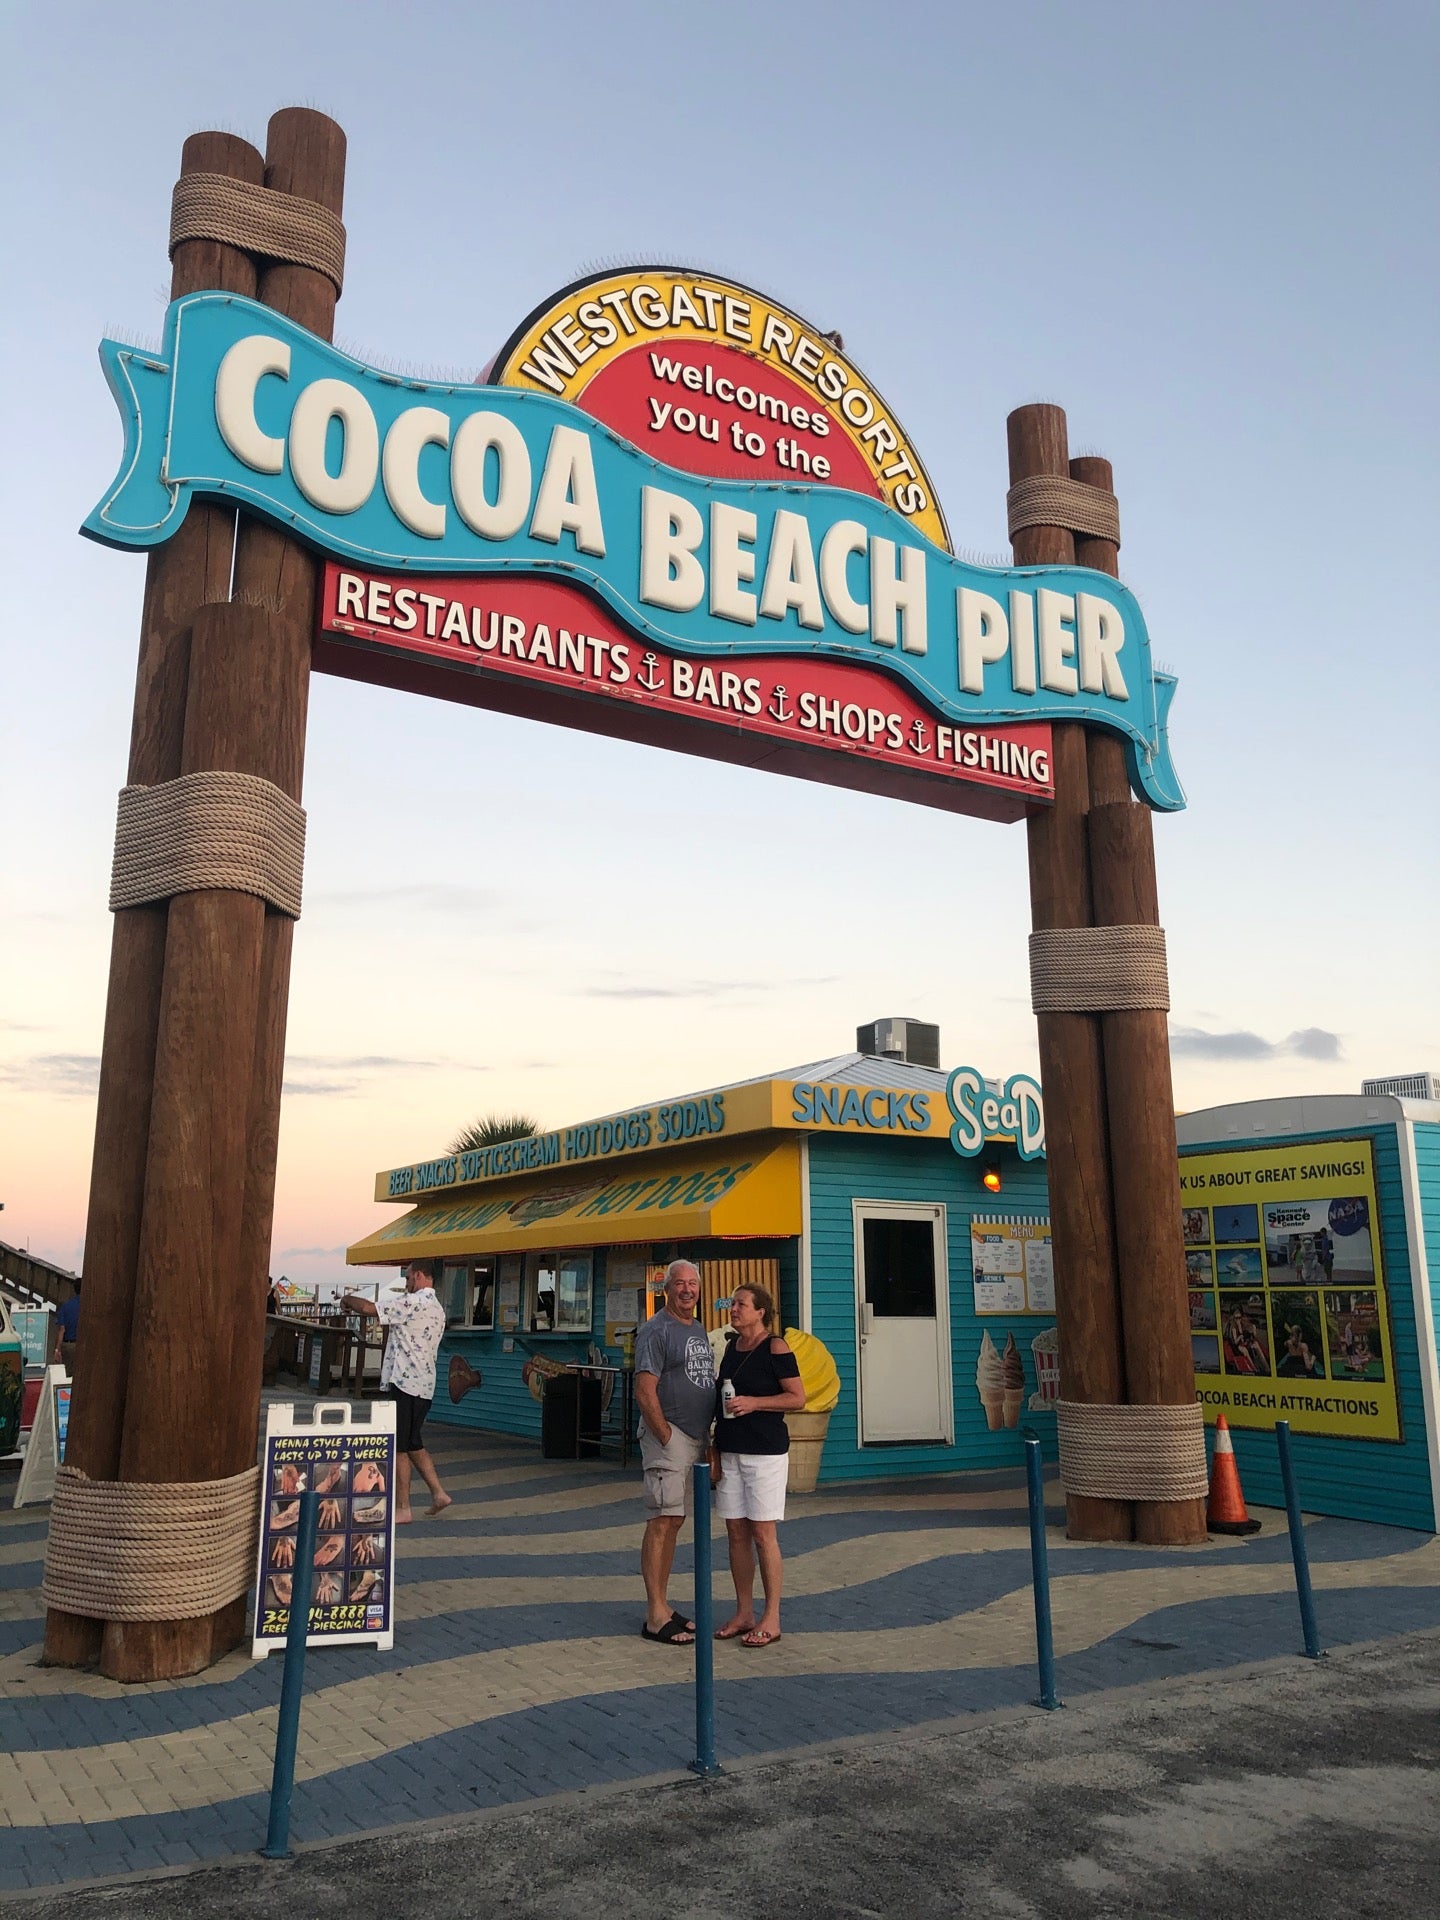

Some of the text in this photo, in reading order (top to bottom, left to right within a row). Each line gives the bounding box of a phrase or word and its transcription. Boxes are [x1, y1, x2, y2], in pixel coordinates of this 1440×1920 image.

[522, 285, 927, 515] WESTGATE RESORTS
[650, 352, 830, 435] welcomes
[650, 397, 831, 479] you to the
[215, 335, 1130, 702] COCOA BEACH PIER
[337, 573, 1050, 782] RESTAURANTS BARS SHOPS FISHING
[792, 1083, 931, 1132] SNACKS
[953, 1072, 1046, 1153] SeaD
[389, 1167, 413, 1195] BEER
[415, 1155, 457, 1191] SNACKS
[657, 1094, 725, 1143] SODAS
[429, 1200, 514, 1235] ISLAND
[575, 1179, 643, 1217] HOT
[634, 1162, 752, 1212] DOGS
[1190, 1174, 1206, 1189] US
[1209, 1171, 1251, 1188] ABOUT
[1255, 1167, 1297, 1184] GREAT
[1300, 1161, 1365, 1180] SAVINGS!
[1010, 1226, 1034, 1237] MENU
[1267, 1212, 1311, 1224] Space
[1328, 1202, 1364, 1220] NASA
[1195, 1390, 1379, 1416] OCOA BEACH ATTRACTIONS
[274, 1448, 389, 1461] LASTS UP TO 3 WEEKS
[275, 1436, 389, 1449] HENNA STYLE TATTOOS
[262, 1623, 288, 1634] FREE
[313, 1620, 365, 1632] PIERCING!
